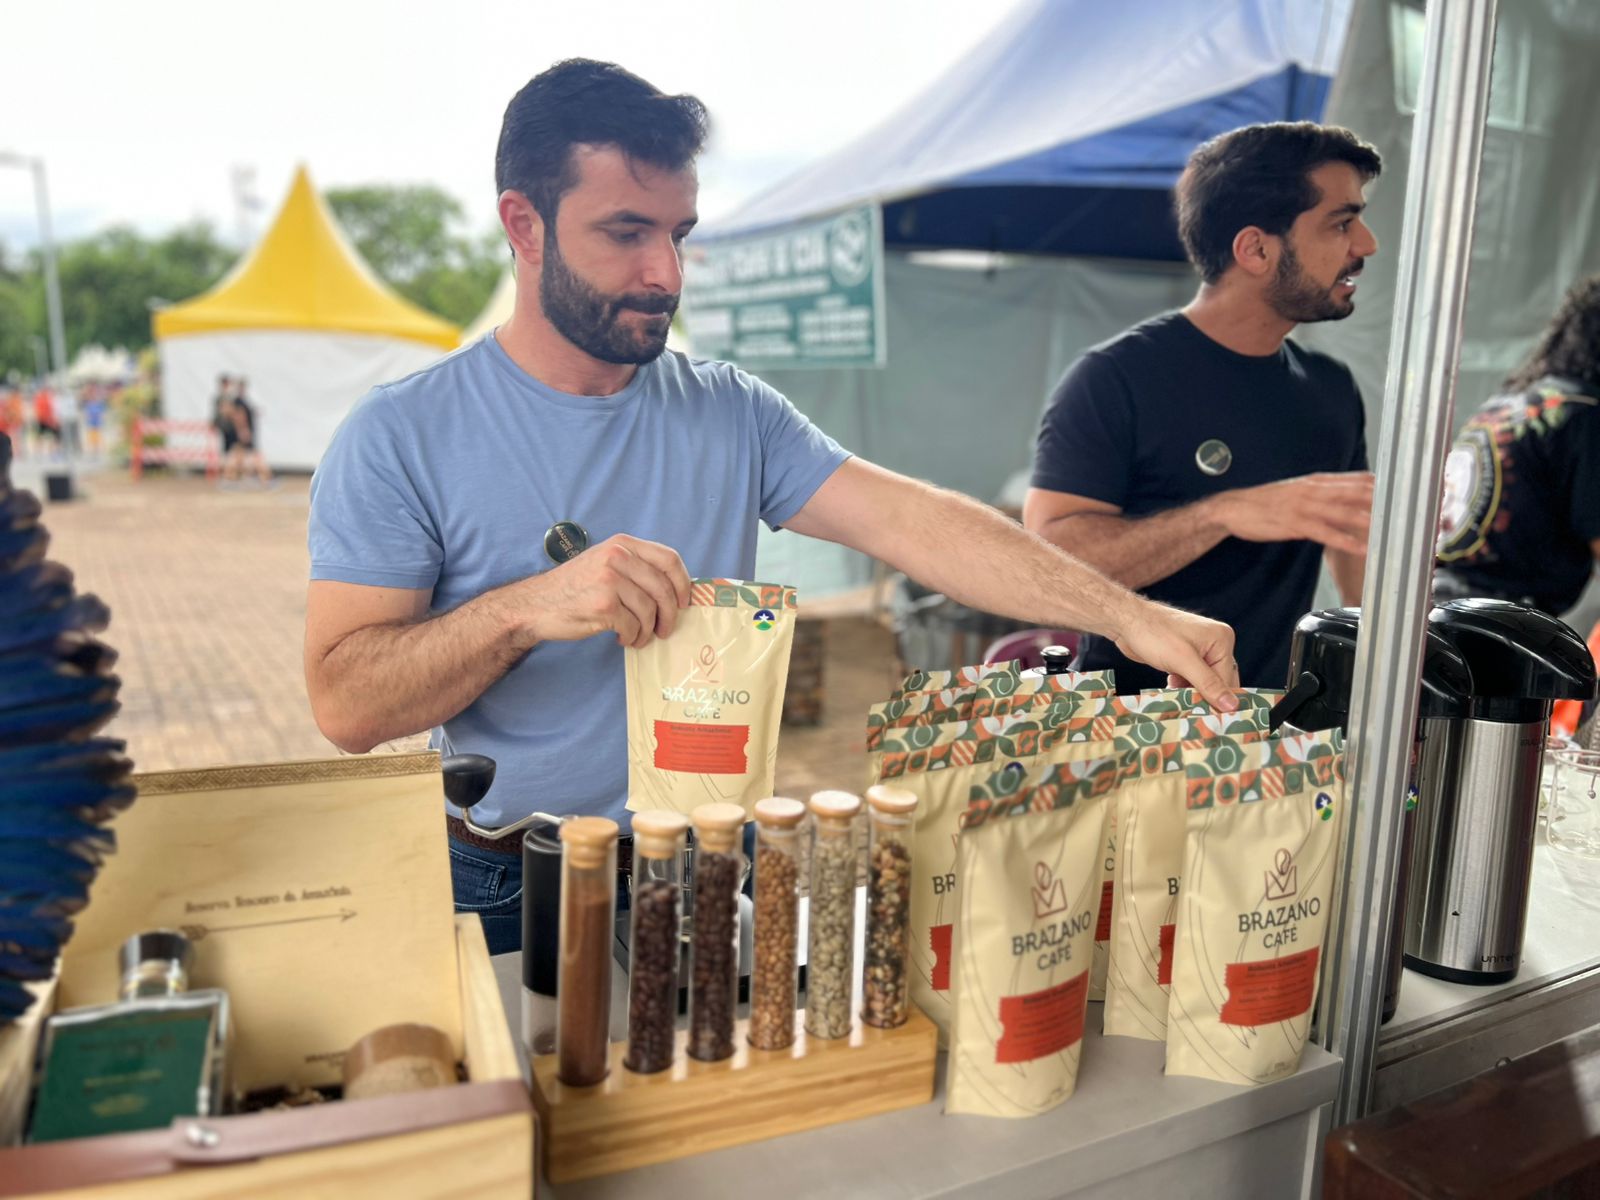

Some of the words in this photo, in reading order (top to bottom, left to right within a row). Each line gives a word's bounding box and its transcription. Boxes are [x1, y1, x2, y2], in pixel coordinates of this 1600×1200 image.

[661, 686, 751, 705] BRAZANO
[1238, 897, 1321, 933] BRAZANO
[1012, 911, 1092, 956] BRAZANO
[1263, 924, 1298, 949] CAFÉ
